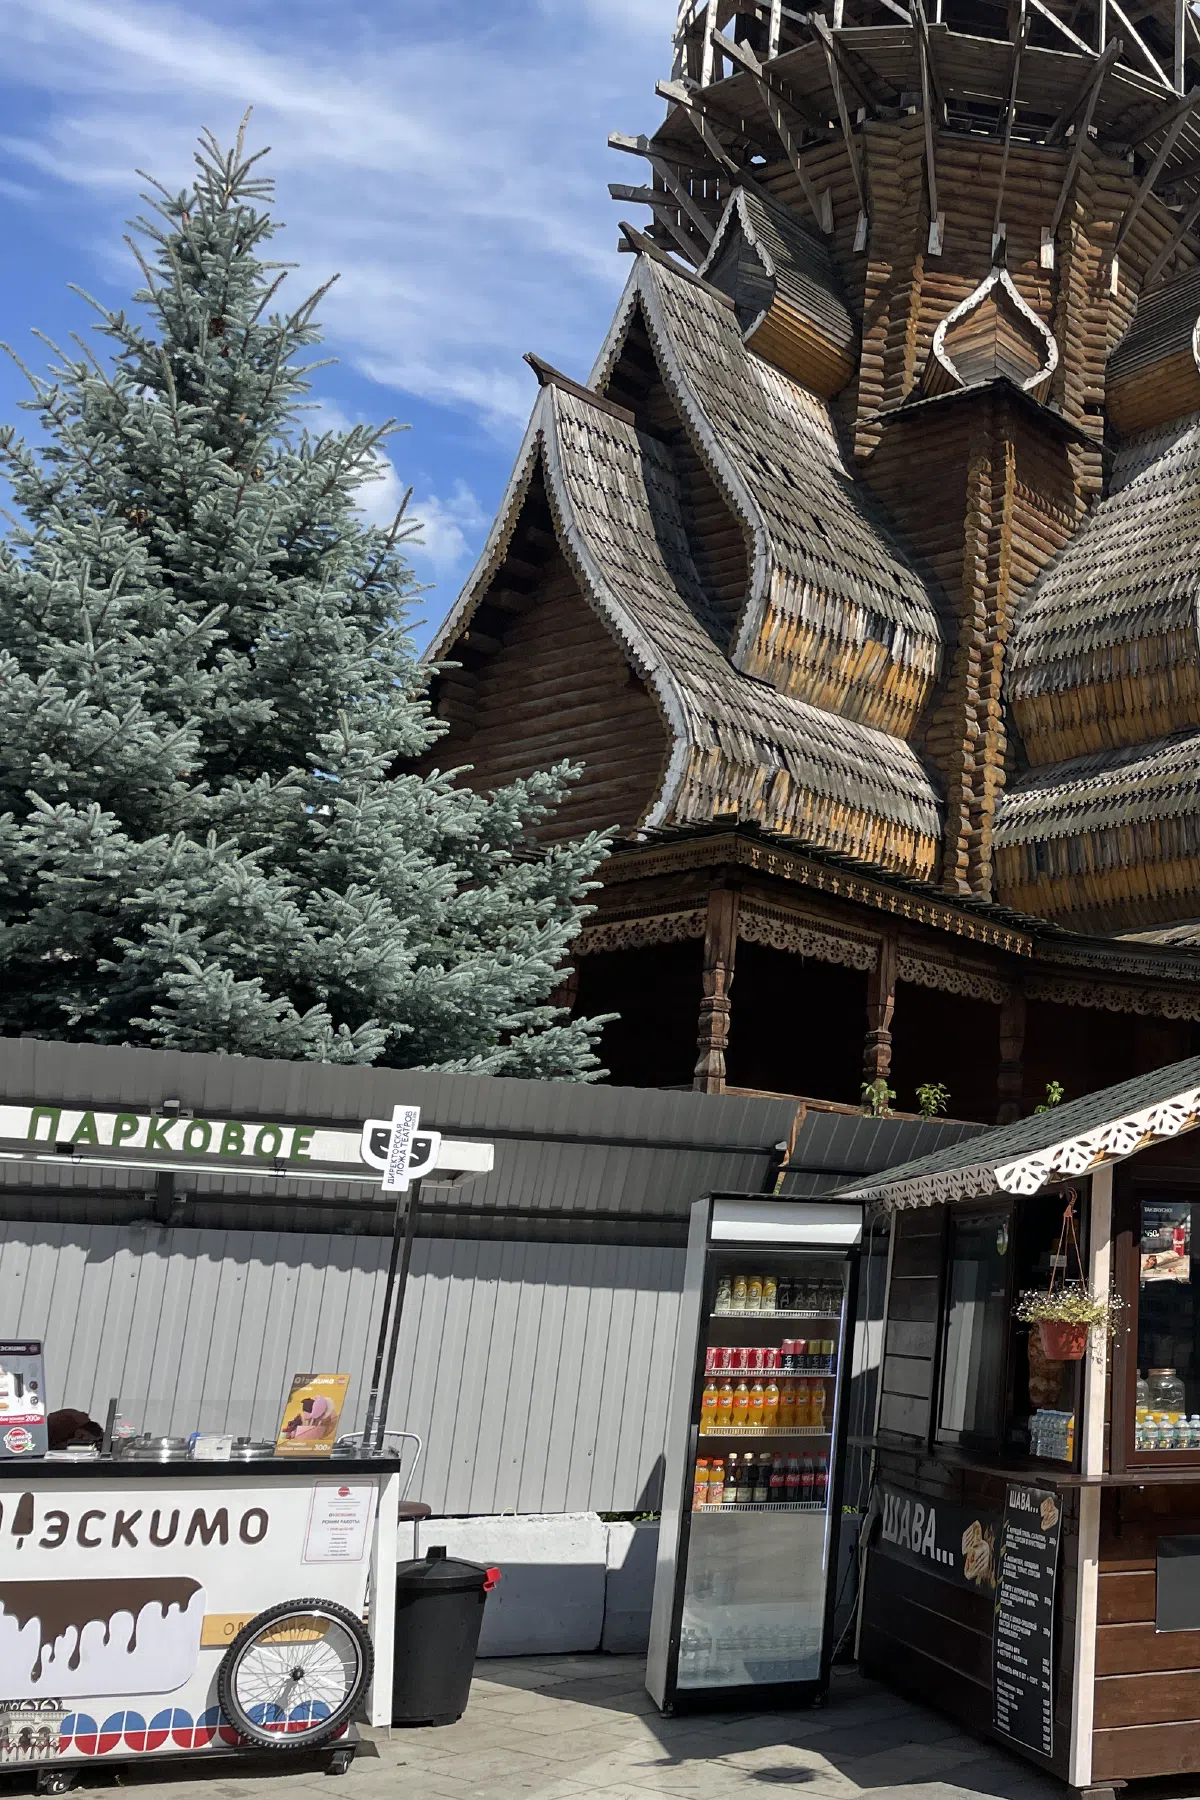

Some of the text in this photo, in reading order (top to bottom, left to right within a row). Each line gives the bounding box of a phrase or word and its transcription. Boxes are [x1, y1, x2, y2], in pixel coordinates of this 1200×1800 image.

[28, 1107, 316, 1161] ПАРКОВОЕ
[387, 1123, 403, 1185] ДИРЕКТОРСКАЯ
[396, 1110, 413, 1176] ЛОЖА ТЕАТРОВ
